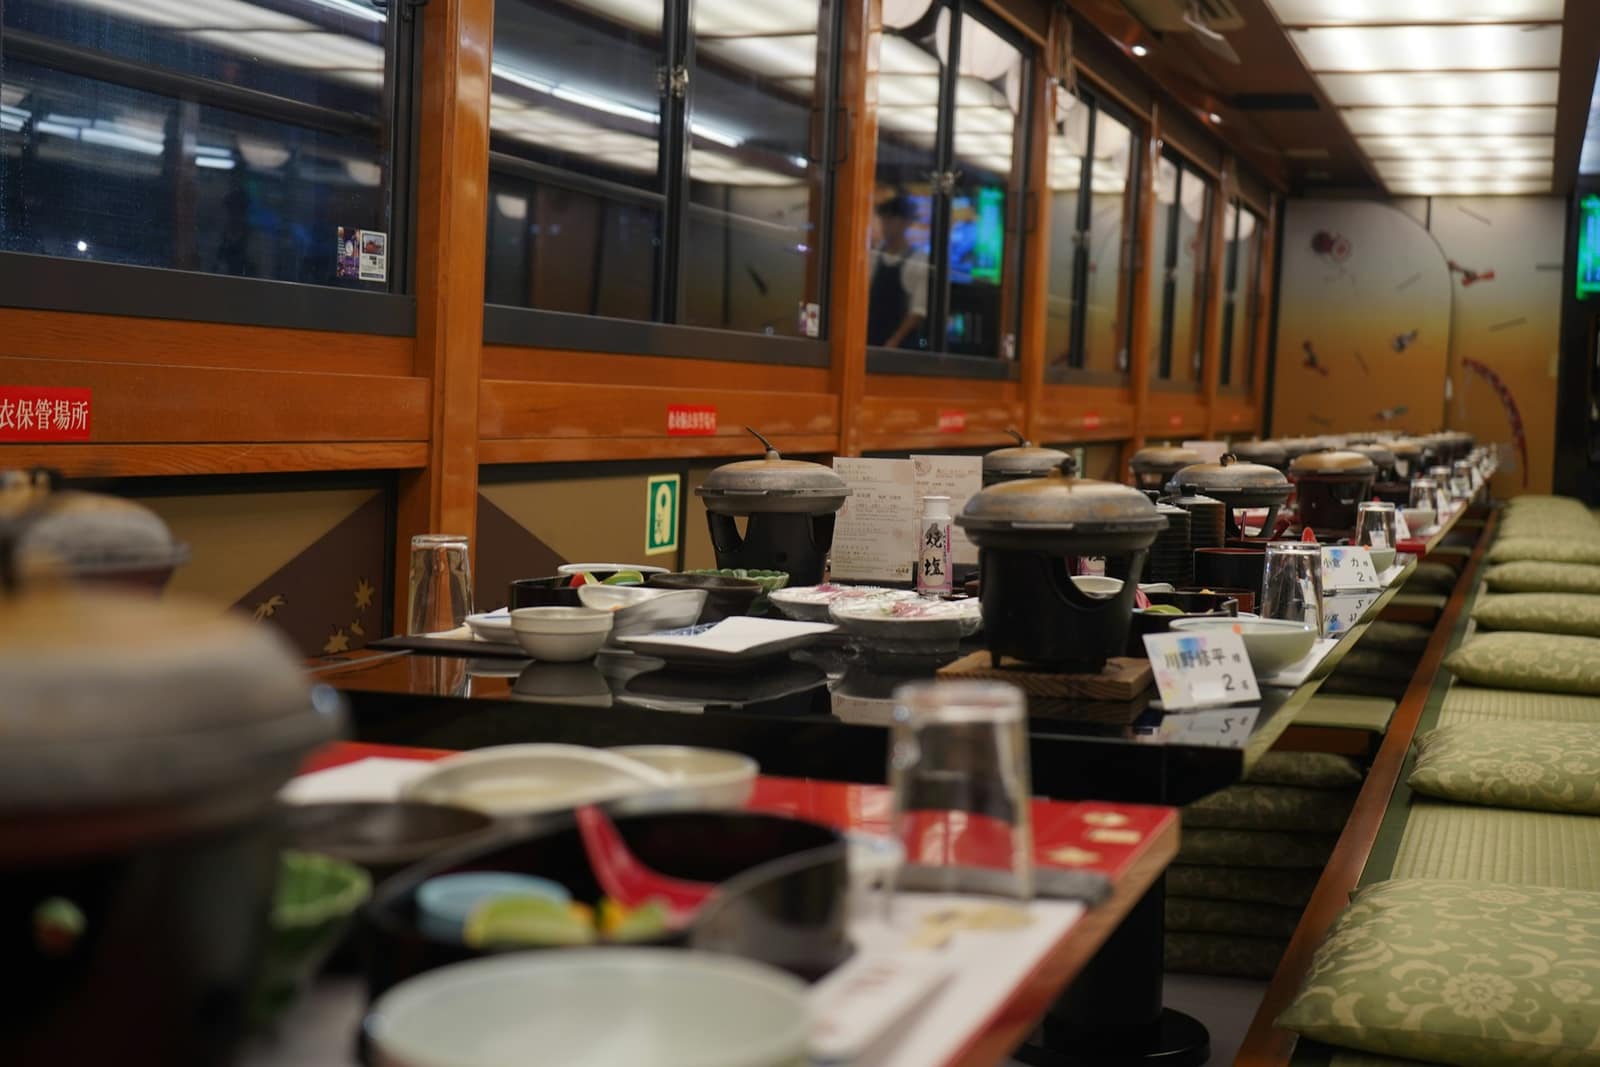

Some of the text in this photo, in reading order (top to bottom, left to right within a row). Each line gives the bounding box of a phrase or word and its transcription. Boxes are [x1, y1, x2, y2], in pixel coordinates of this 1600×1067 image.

[0, 398, 88, 430] 衣保管場所
[925, 523, 944, 576] 焼塩
[1357, 572, 1365, 582] 2
[1222, 673, 1235, 691] 2
